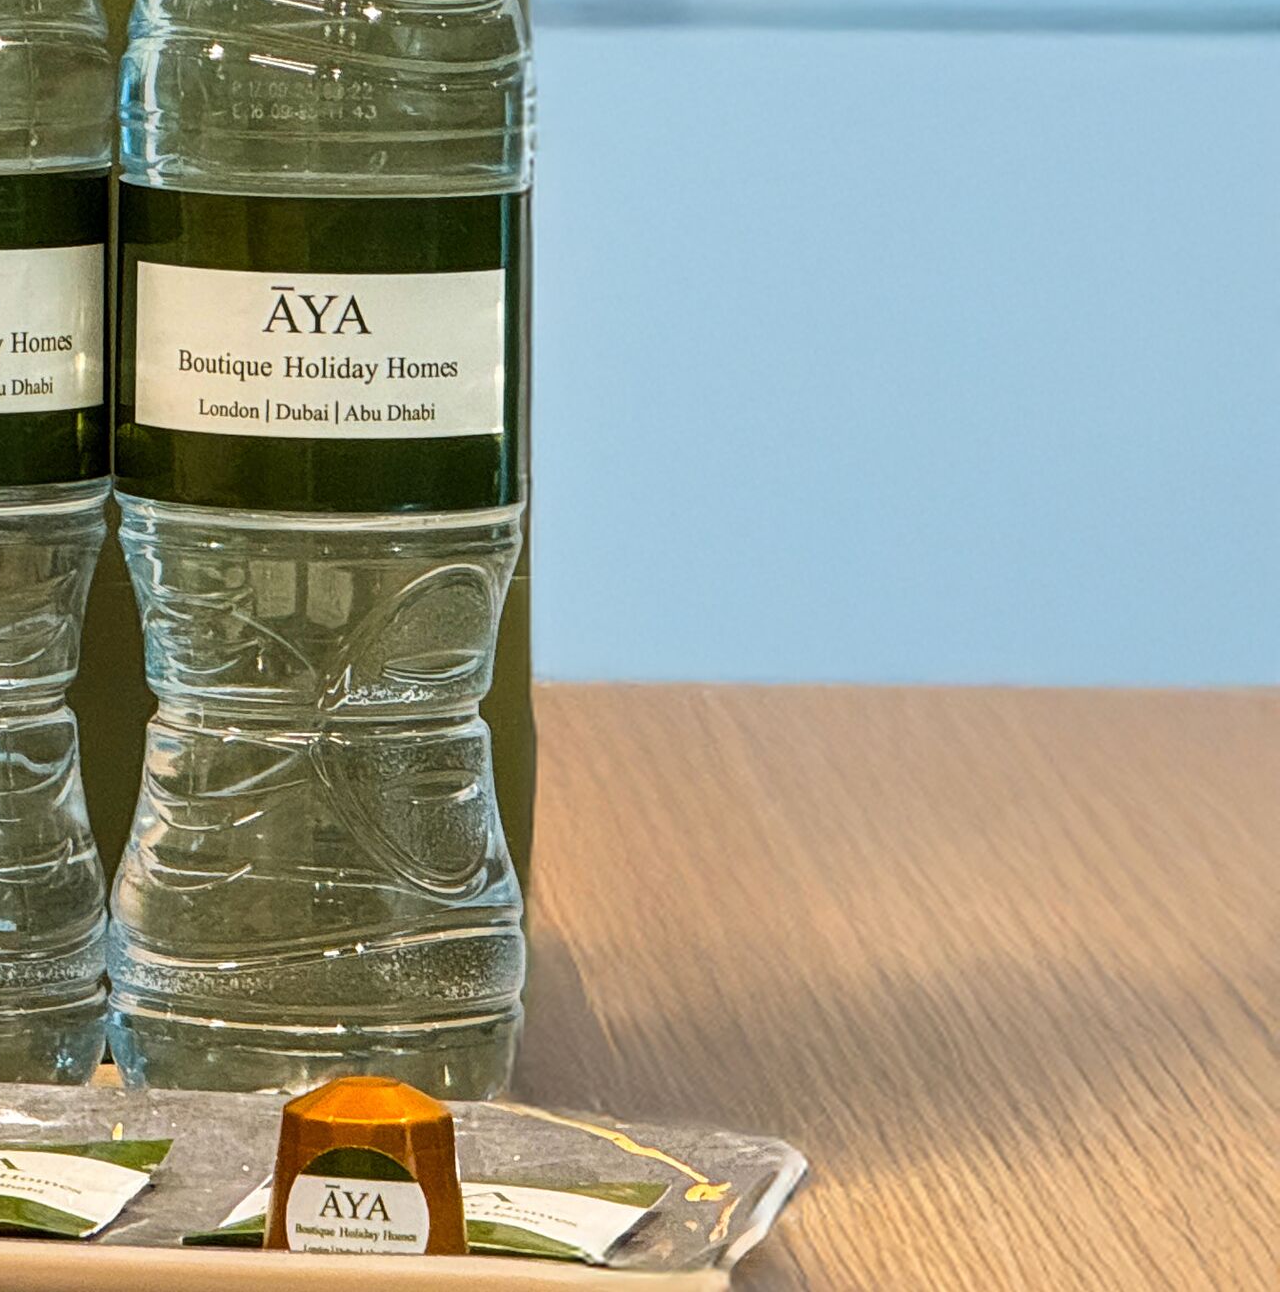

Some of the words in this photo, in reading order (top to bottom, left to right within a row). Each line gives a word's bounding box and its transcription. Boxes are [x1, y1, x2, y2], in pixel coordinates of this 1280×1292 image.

[262, 286, 372, 335] ĀYA
[10, 332, 73, 354] Homes
[178, 349, 273, 382] Boutique
[284, 356, 379, 384] Holiday
[386, 357, 458, 378] Homes
[11, 376, 53, 395] Dhabi
[199, 398, 260, 419] London
[275, 403, 330, 422] Dubai
[344, 404, 382, 422] Abu
[387, 403, 436, 422] Dhabi
[319, 1184, 391, 1222] ĀYA
[339, 1226, 380, 1242] Holiday
